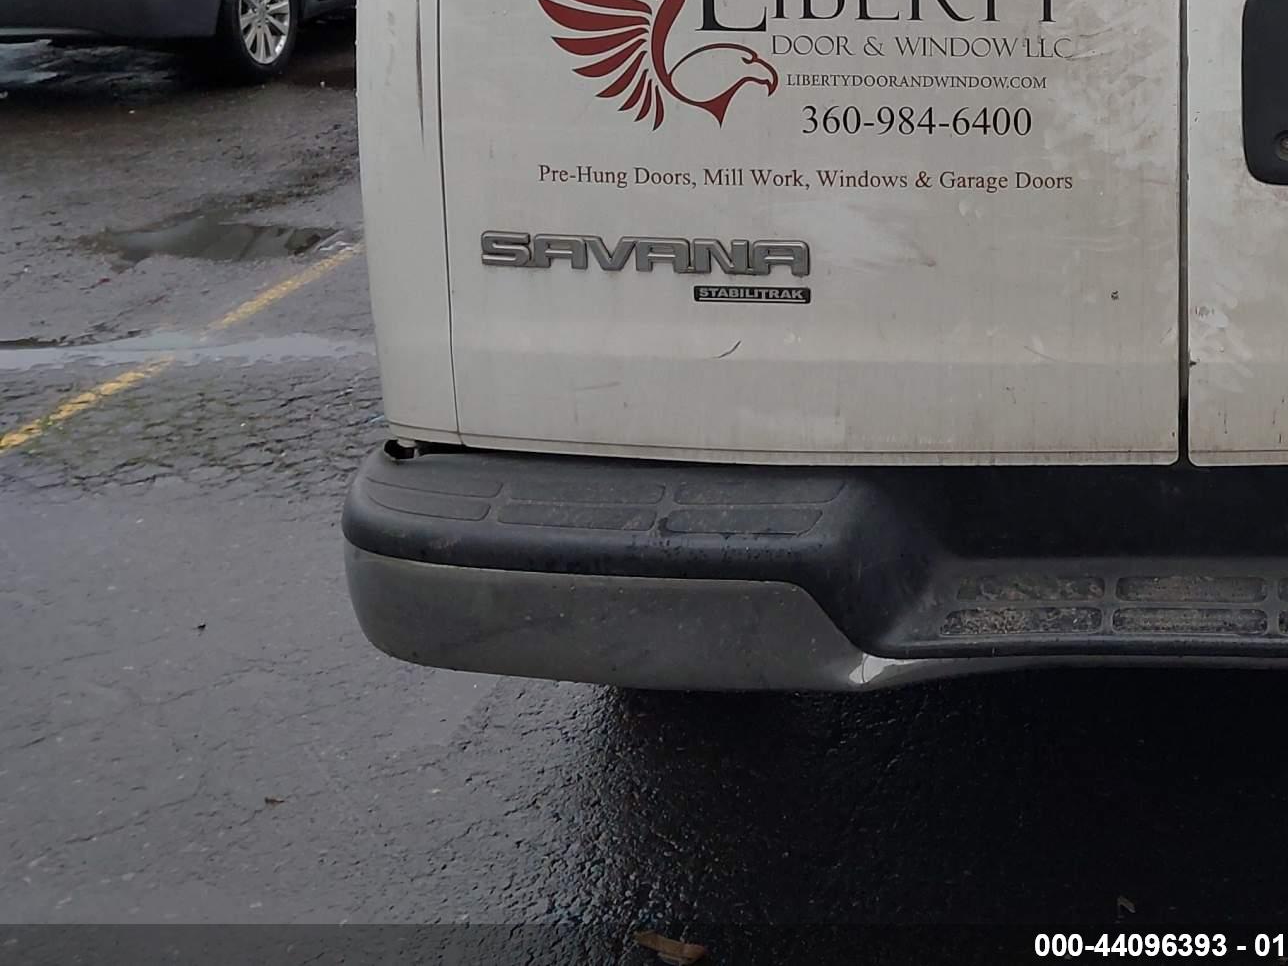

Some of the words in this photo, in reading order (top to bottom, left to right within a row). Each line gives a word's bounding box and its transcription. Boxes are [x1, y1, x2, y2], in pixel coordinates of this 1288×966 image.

[771, 35, 853, 57] DOOR
[863, 36, 885, 57] &
[896, 37, 1018, 58] WINDOW
[1024, 37, 1074, 59] LLC
[786, 73, 1047, 89] LIBERTYDOORANDWINDOW.COM
[801, 105, 1033, 136] 360-984-6400
[538, 164, 628, 188] Pre-Hung
[633, 167, 697, 189] Doors,
[703, 168, 743, 186] Mill
[750, 169, 810, 190] Work,
[816, 170, 908, 188] Windows
[915, 171, 932, 189] &
[939, 171, 1008, 193] Garage
[1015, 172, 1073, 190] Doors
[481, 230, 810, 276] SAVANA
[699, 286, 804, 300] STABILITRAK
